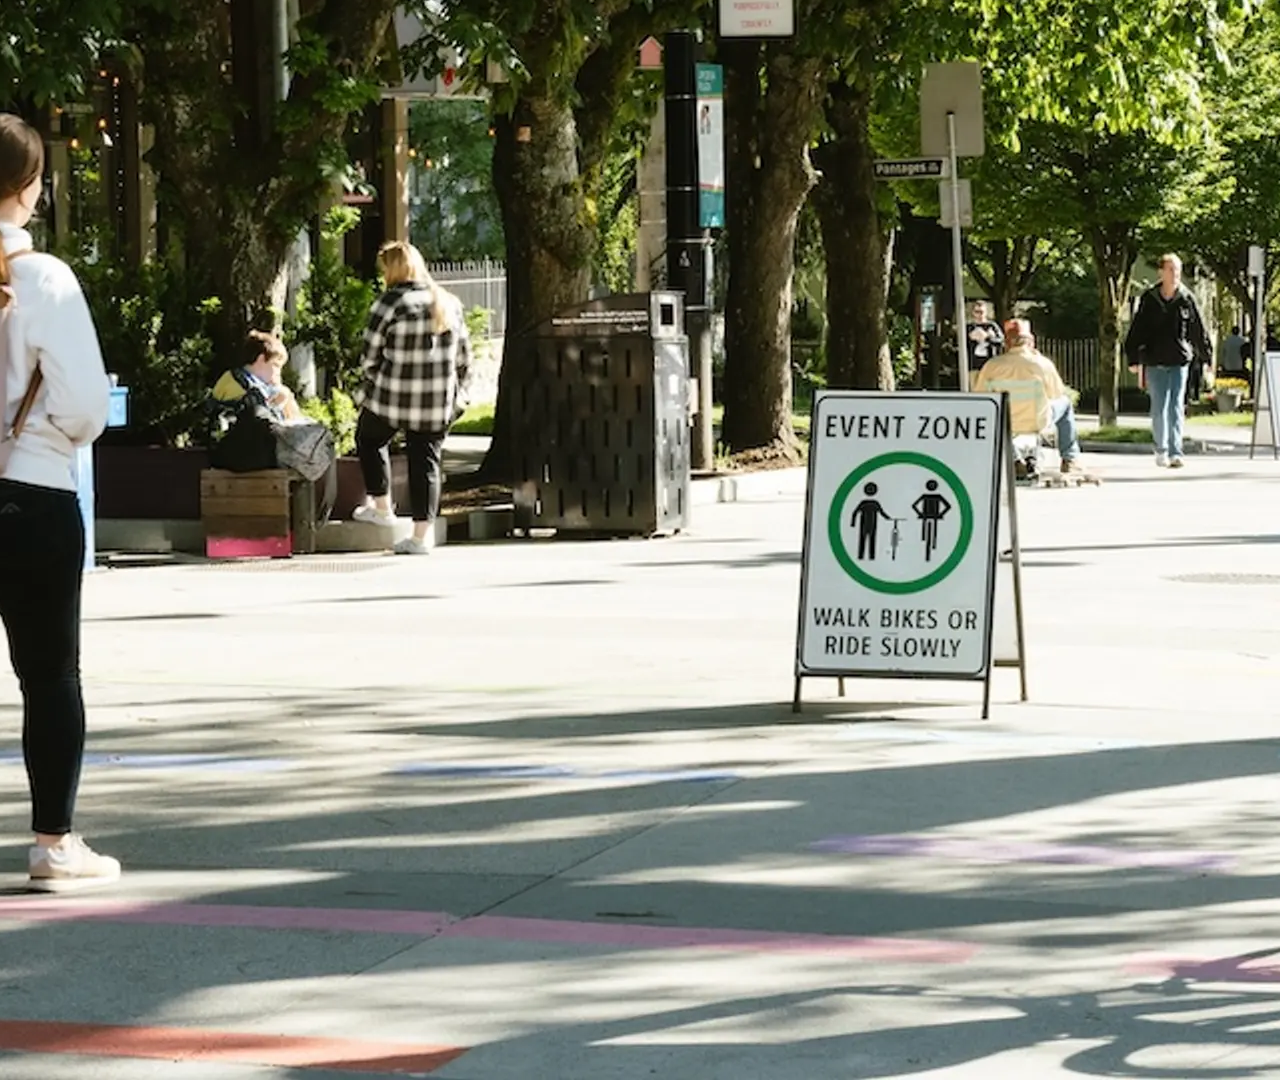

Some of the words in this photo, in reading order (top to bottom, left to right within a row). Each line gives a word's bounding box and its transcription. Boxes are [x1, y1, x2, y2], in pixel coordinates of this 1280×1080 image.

[876, 162, 926, 175] Pantages
[825, 415, 905, 439] EVENT
[918, 416, 987, 440] ZONE
[813, 607, 870, 628] WALK
[880, 609, 938, 629] BIKES
[948, 610, 978, 630] OR
[825, 636, 871, 656] RIDE
[880, 637, 962, 658] SLOWLY
